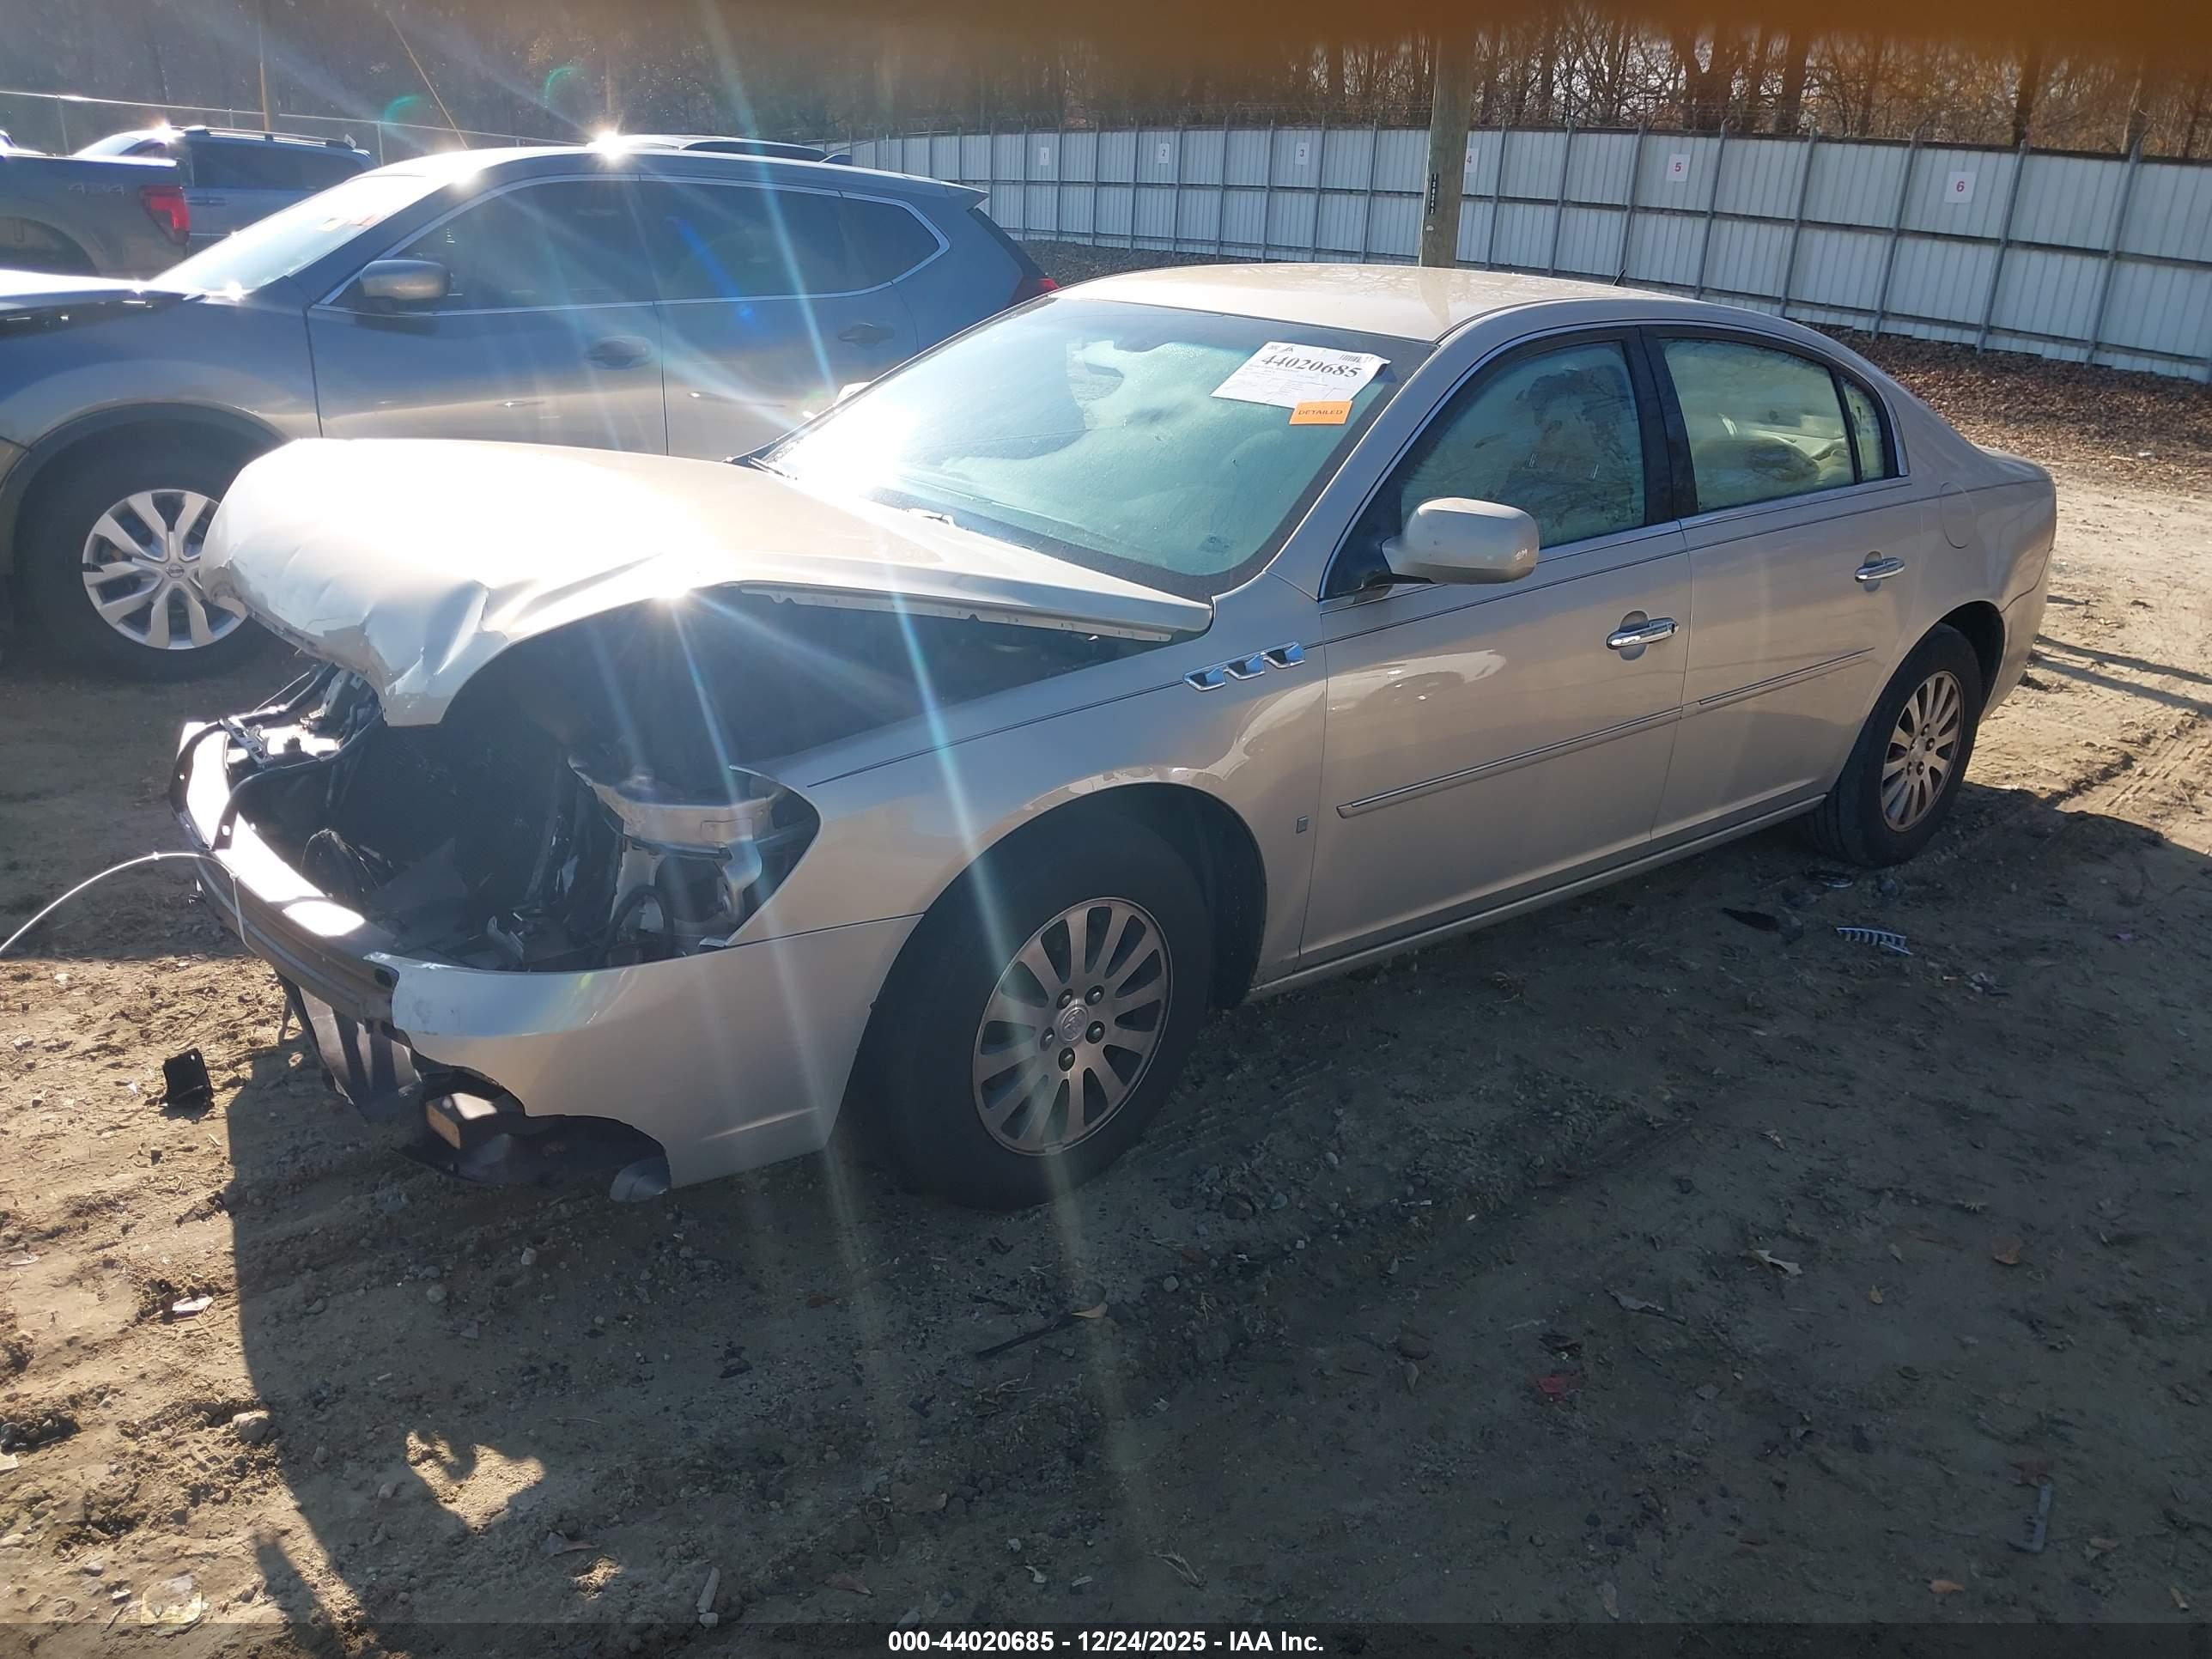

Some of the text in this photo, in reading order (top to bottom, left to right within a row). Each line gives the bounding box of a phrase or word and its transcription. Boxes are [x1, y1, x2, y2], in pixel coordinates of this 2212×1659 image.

[1299, 149, 1305, 157] 3
[1466, 155, 1472, 164] 4
[1674, 161, 1682, 172] 5
[1956, 180, 1965, 192] 6
[1261, 353, 1364, 379] 44020685
